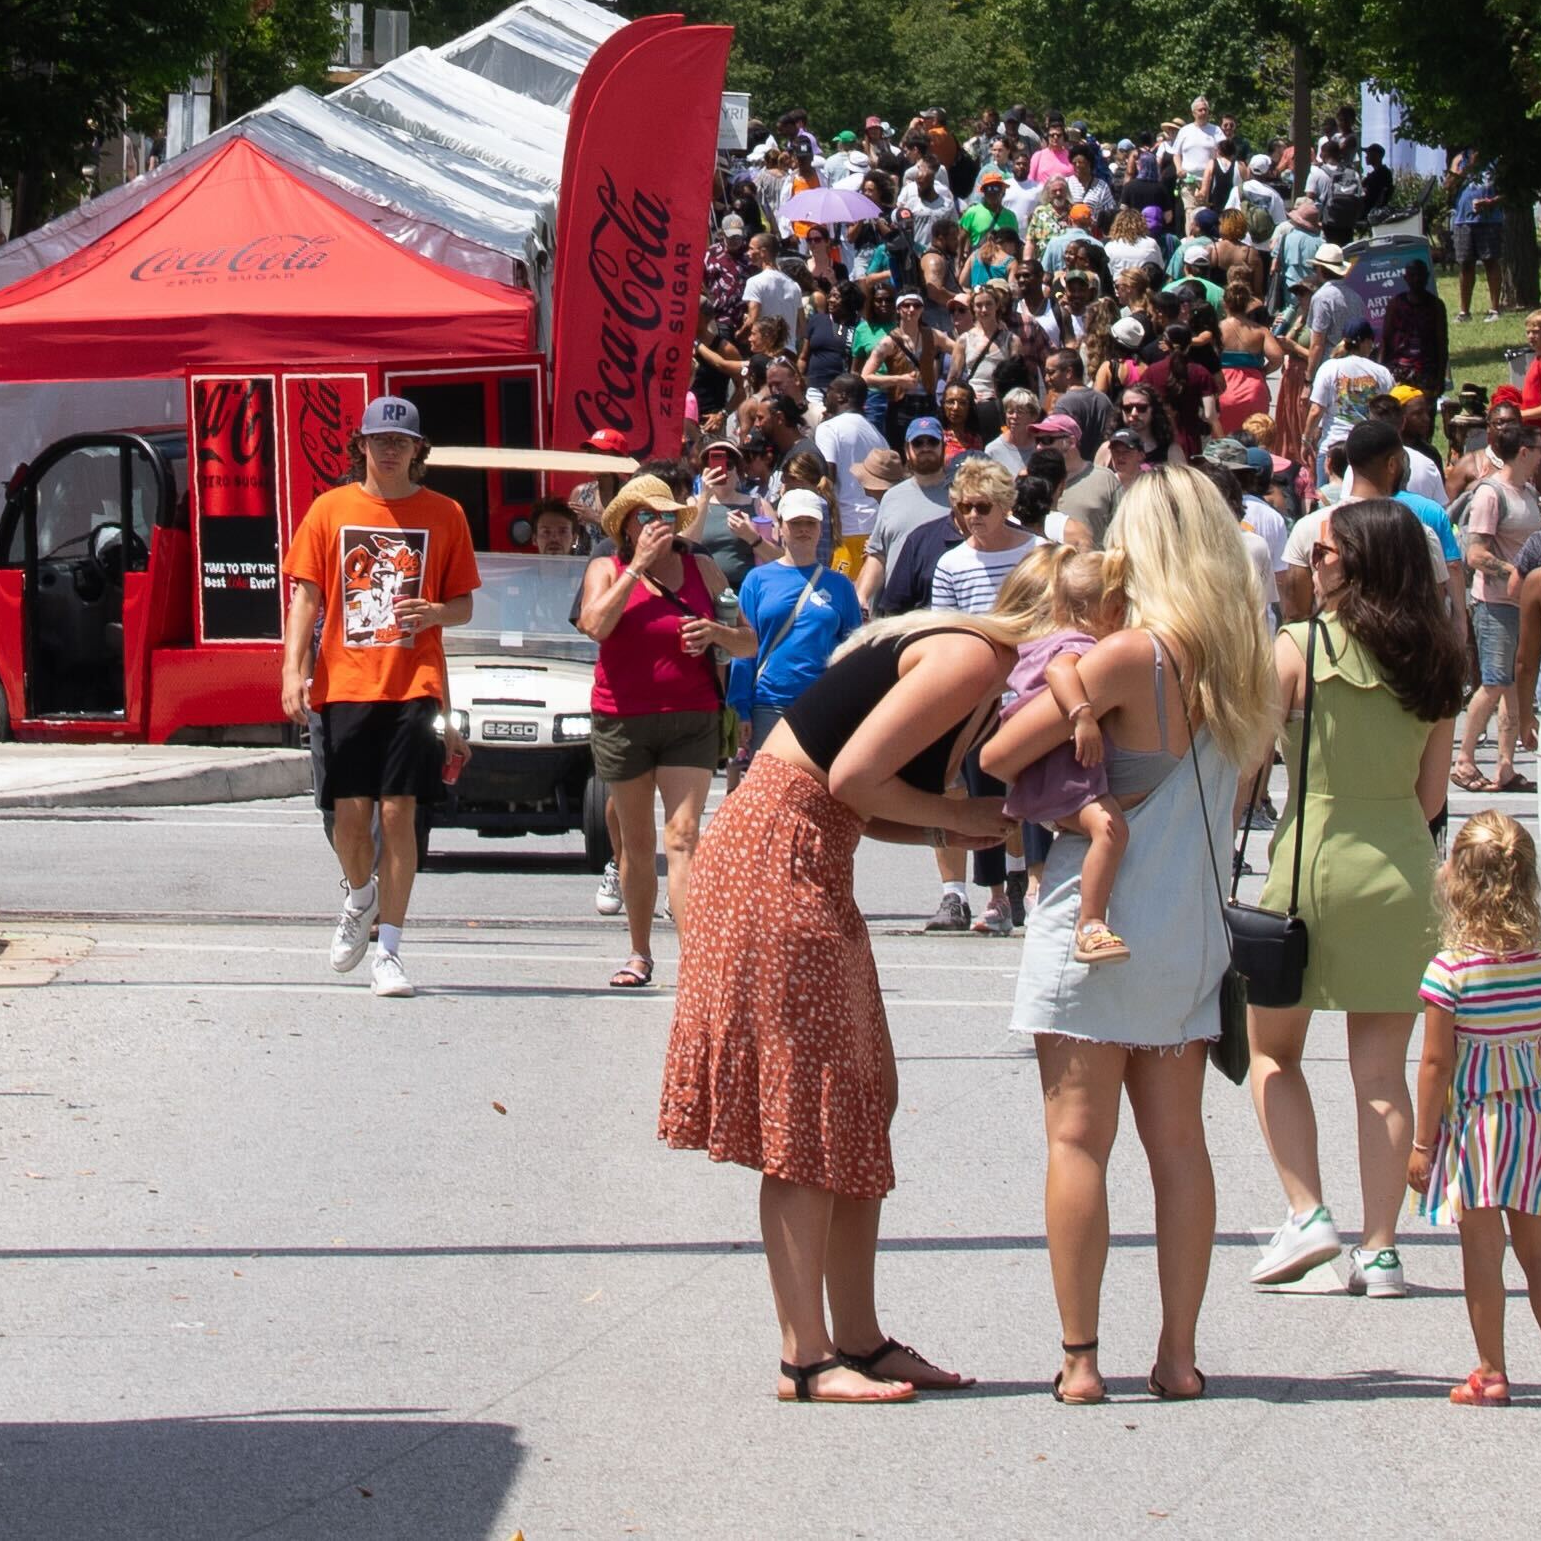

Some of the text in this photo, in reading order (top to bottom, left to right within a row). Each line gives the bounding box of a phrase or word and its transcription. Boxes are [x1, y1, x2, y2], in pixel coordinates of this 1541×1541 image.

[165, 272, 296, 288] ZERO SUGAR
[659, 242, 692, 418] ZERO SUGAR
[382, 404, 407, 421] RP
[225, 562, 240, 575] TO
[239, 562, 258, 575] TRY
[257, 563, 277, 575] THE
[203, 576, 227, 589] Best
[249, 576, 277, 590] Ever?
